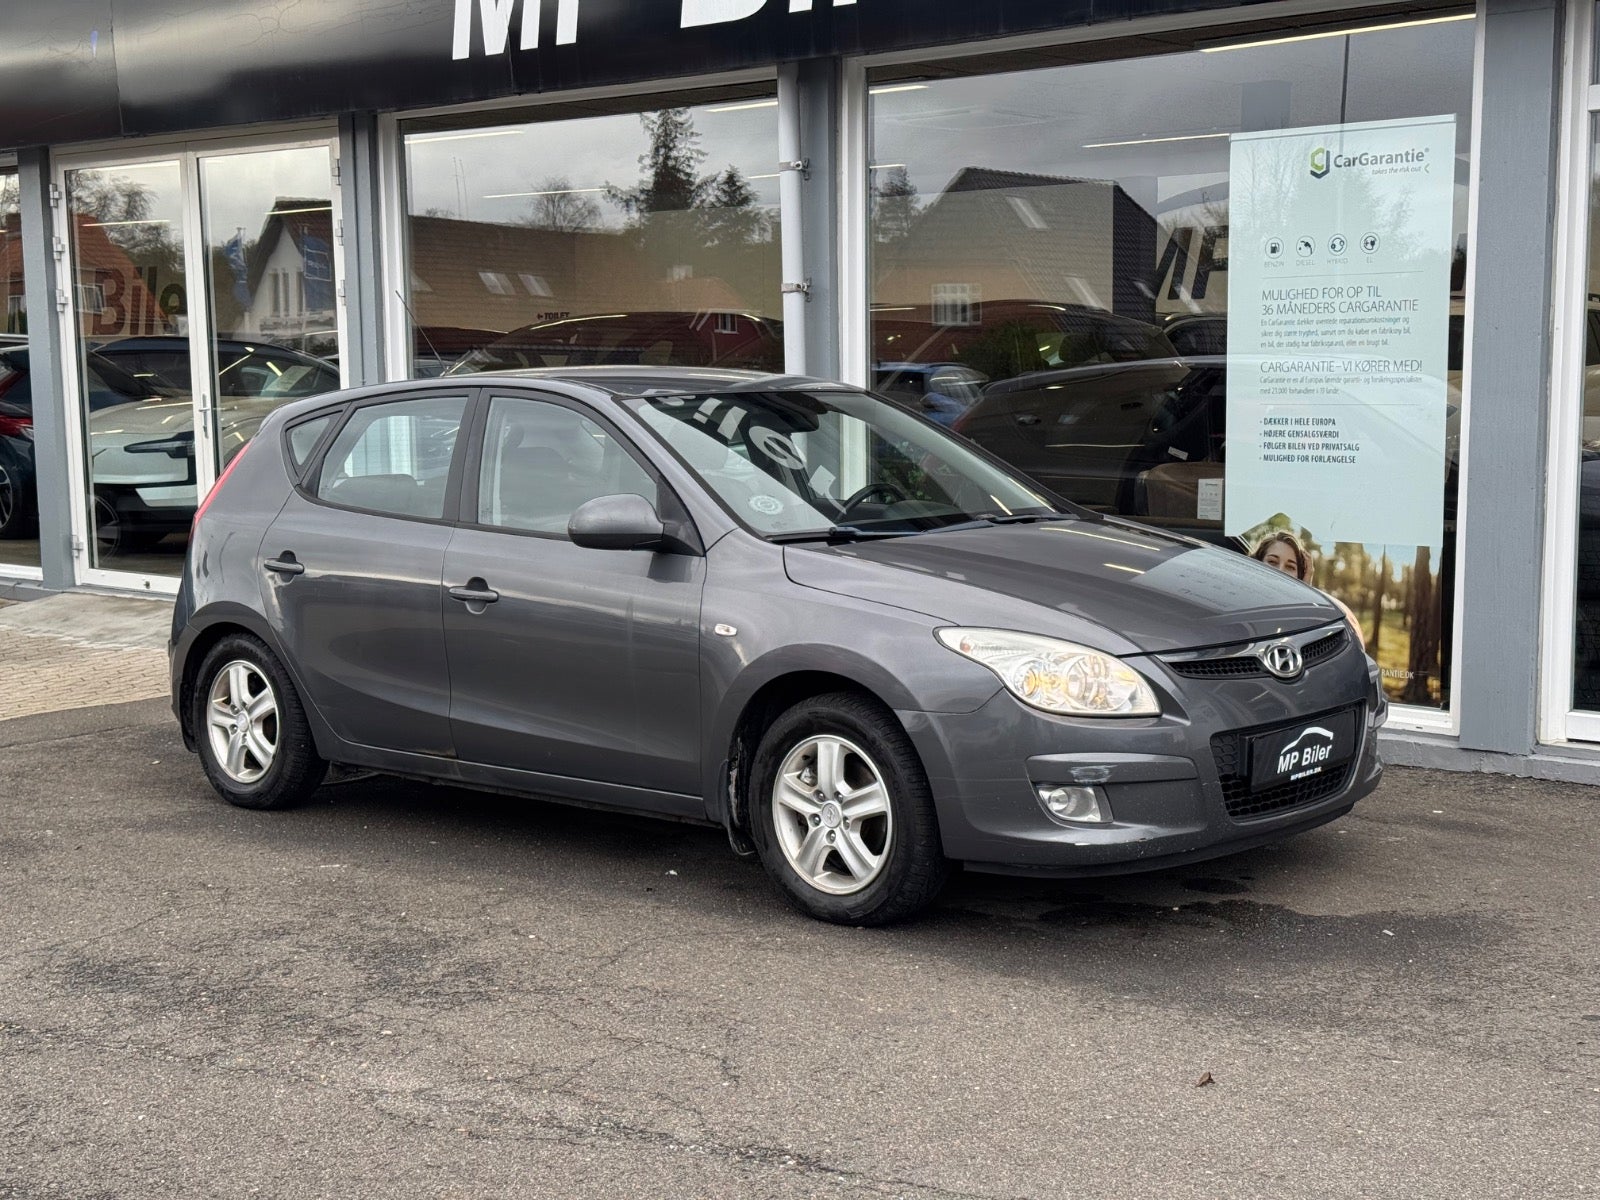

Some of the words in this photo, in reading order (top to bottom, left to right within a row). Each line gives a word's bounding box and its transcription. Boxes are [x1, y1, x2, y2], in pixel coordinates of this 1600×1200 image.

[1261, 288, 1319, 301] MULIGHED
[1322, 286, 1344, 299] FOR
[1346, 286, 1363, 298] OP
[1366, 285, 1382, 298] TIL
[1261, 304, 1274, 316] 36
[1276, 301, 1336, 315] MÅNEDERS
[1338, 299, 1419, 313] CARGARANTIE
[1355, 360, 1390, 373] KØRER
[1393, 360, 1423, 372] MED!
[1263, 417, 1289, 426] DÆKKER
[1294, 418, 1310, 426] HELE
[1312, 418, 1336, 426] EUROPA
[1263, 430, 1286, 438] HØJERE
[1287, 430, 1340, 438] GENSALGSVÆRDI
[1263, 442, 1287, 450] FØLGER
[1288, 442, 1306, 450] BILEN
[1308, 442, 1320, 450] VED
[1321, 443, 1360, 451] PRIVATSALG
[1263, 454, 1296, 462] MULIGHED
[1297, 454, 1310, 463] FOR
[1311, 455, 1356, 463] FORLÆNGELSE
[1381, 668, 1415, 680] RANTIE.DK
[1277, 751, 1299, 774] MP
[1301, 744, 1333, 766] Biler
